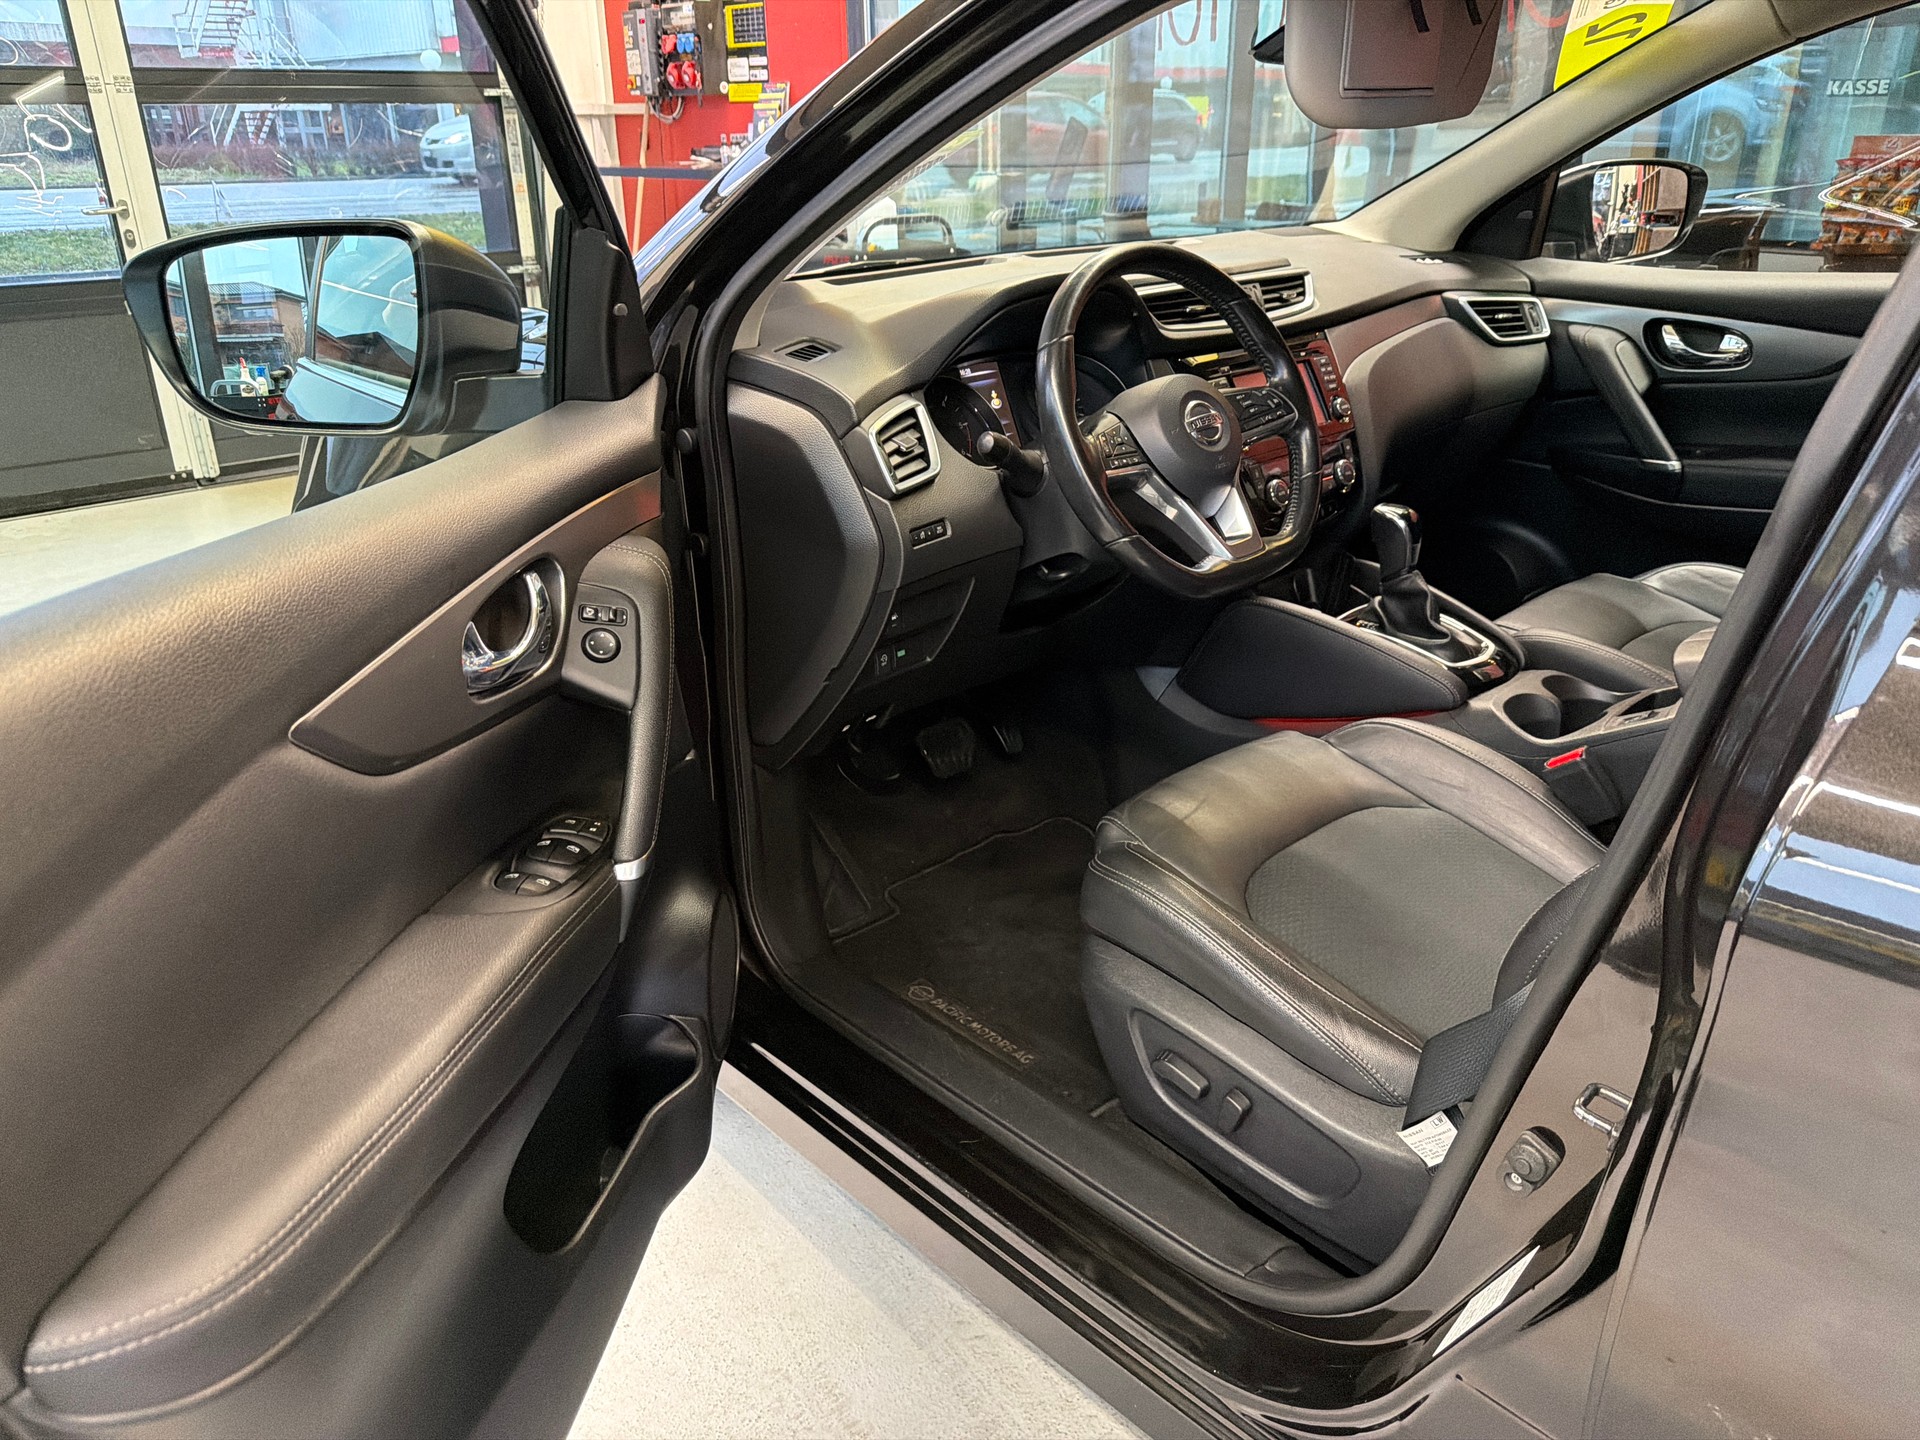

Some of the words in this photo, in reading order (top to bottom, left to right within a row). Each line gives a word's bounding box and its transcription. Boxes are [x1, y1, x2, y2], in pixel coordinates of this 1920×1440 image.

[1826, 79, 1891, 96] KASSE
[930, 998, 973, 1024] PACIFIC
[966, 1021, 1018, 1053] MOTORS
[1012, 1050, 1034, 1064] AG
[1432, 1115, 1444, 1126] LW
